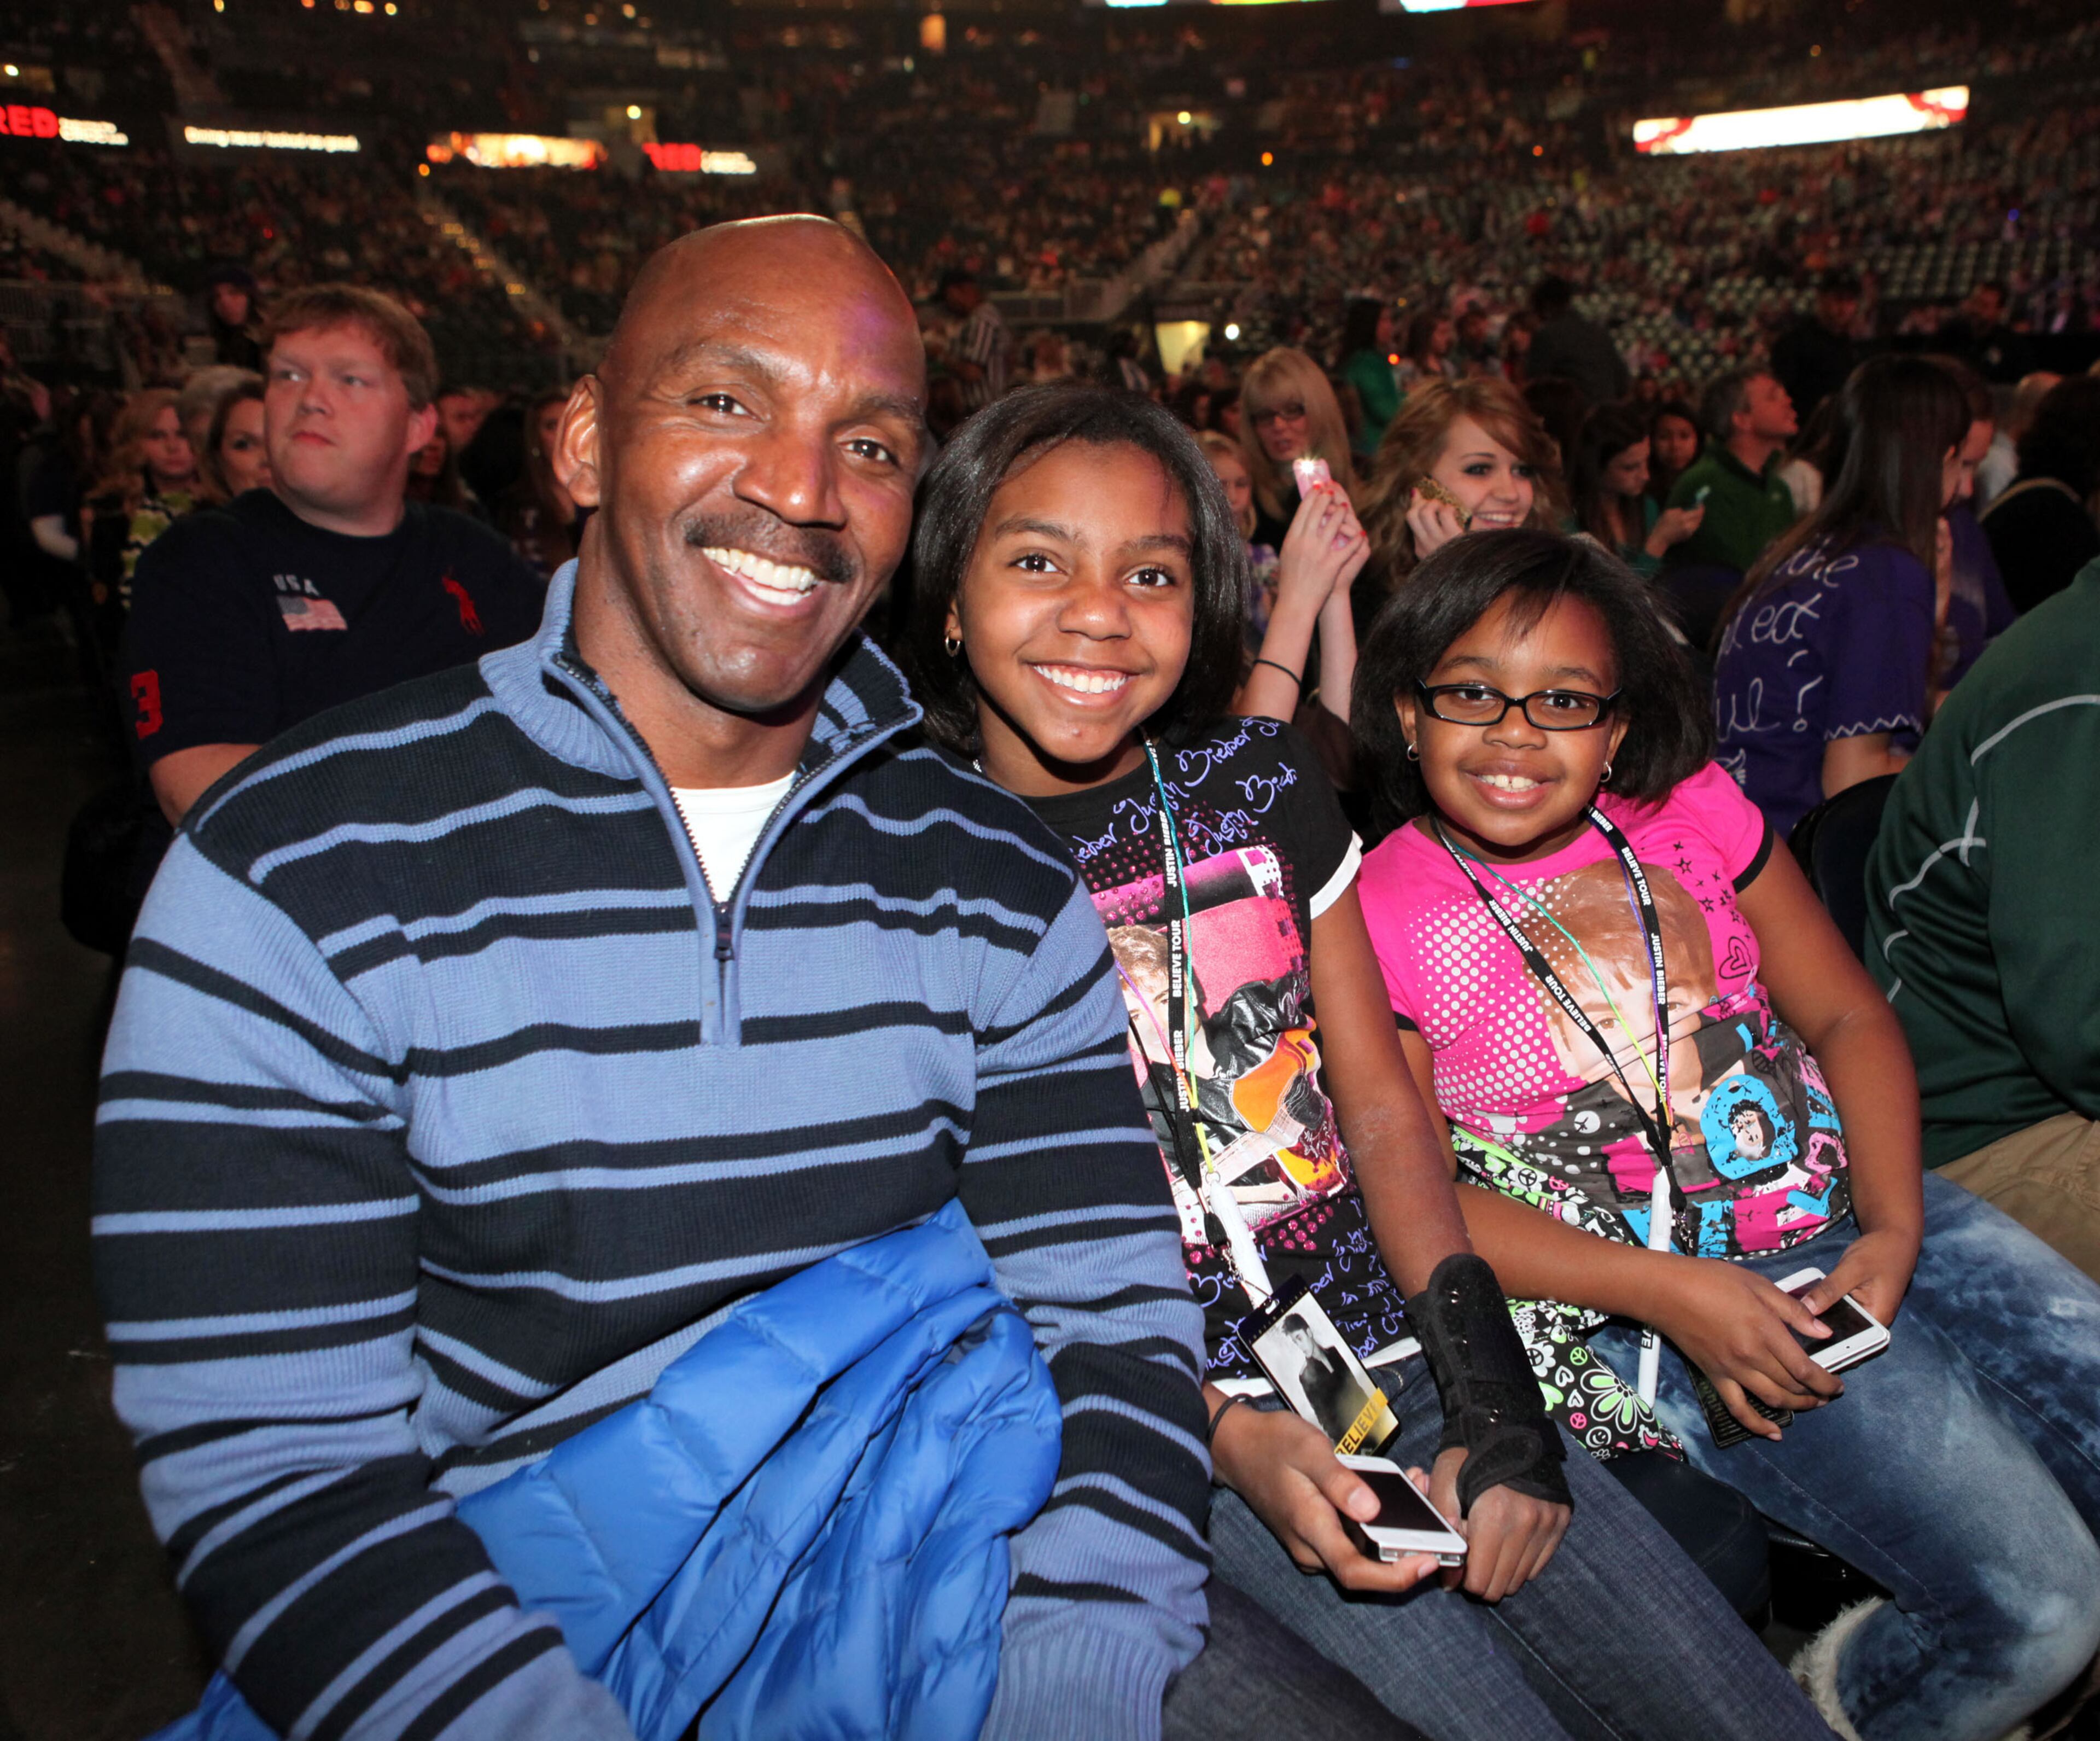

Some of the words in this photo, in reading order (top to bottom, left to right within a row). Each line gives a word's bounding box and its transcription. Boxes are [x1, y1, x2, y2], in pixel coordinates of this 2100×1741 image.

[0, 106, 59, 138] ED
[274, 574, 319, 596] USA
[130, 669, 164, 740] 3
[1175, 729, 1251, 787] Bieber
[1159, 810, 1172, 848] BIEBER
[1185, 808, 1259, 857] Justin
[1590, 809, 1614, 833] BIEBER
[1164, 849, 1178, 887] JUSTIN
[1621, 846, 1644, 879] BELIEVE
[1637, 878, 1652, 906] TOUR
[1488, 899, 1512, 927] BIEBER
[1171, 919, 1181, 950] TOUR
[1507, 924, 1534, 952] JUSTIN
[1650, 932, 1664, 968] JUSTIN
[1172, 952, 1182, 998] BELIEVE
[1545, 974, 1566, 1001] TOUR
[1656, 969, 1666, 1005] BIEBER
[1563, 999, 1592, 1033] BELIEVE
